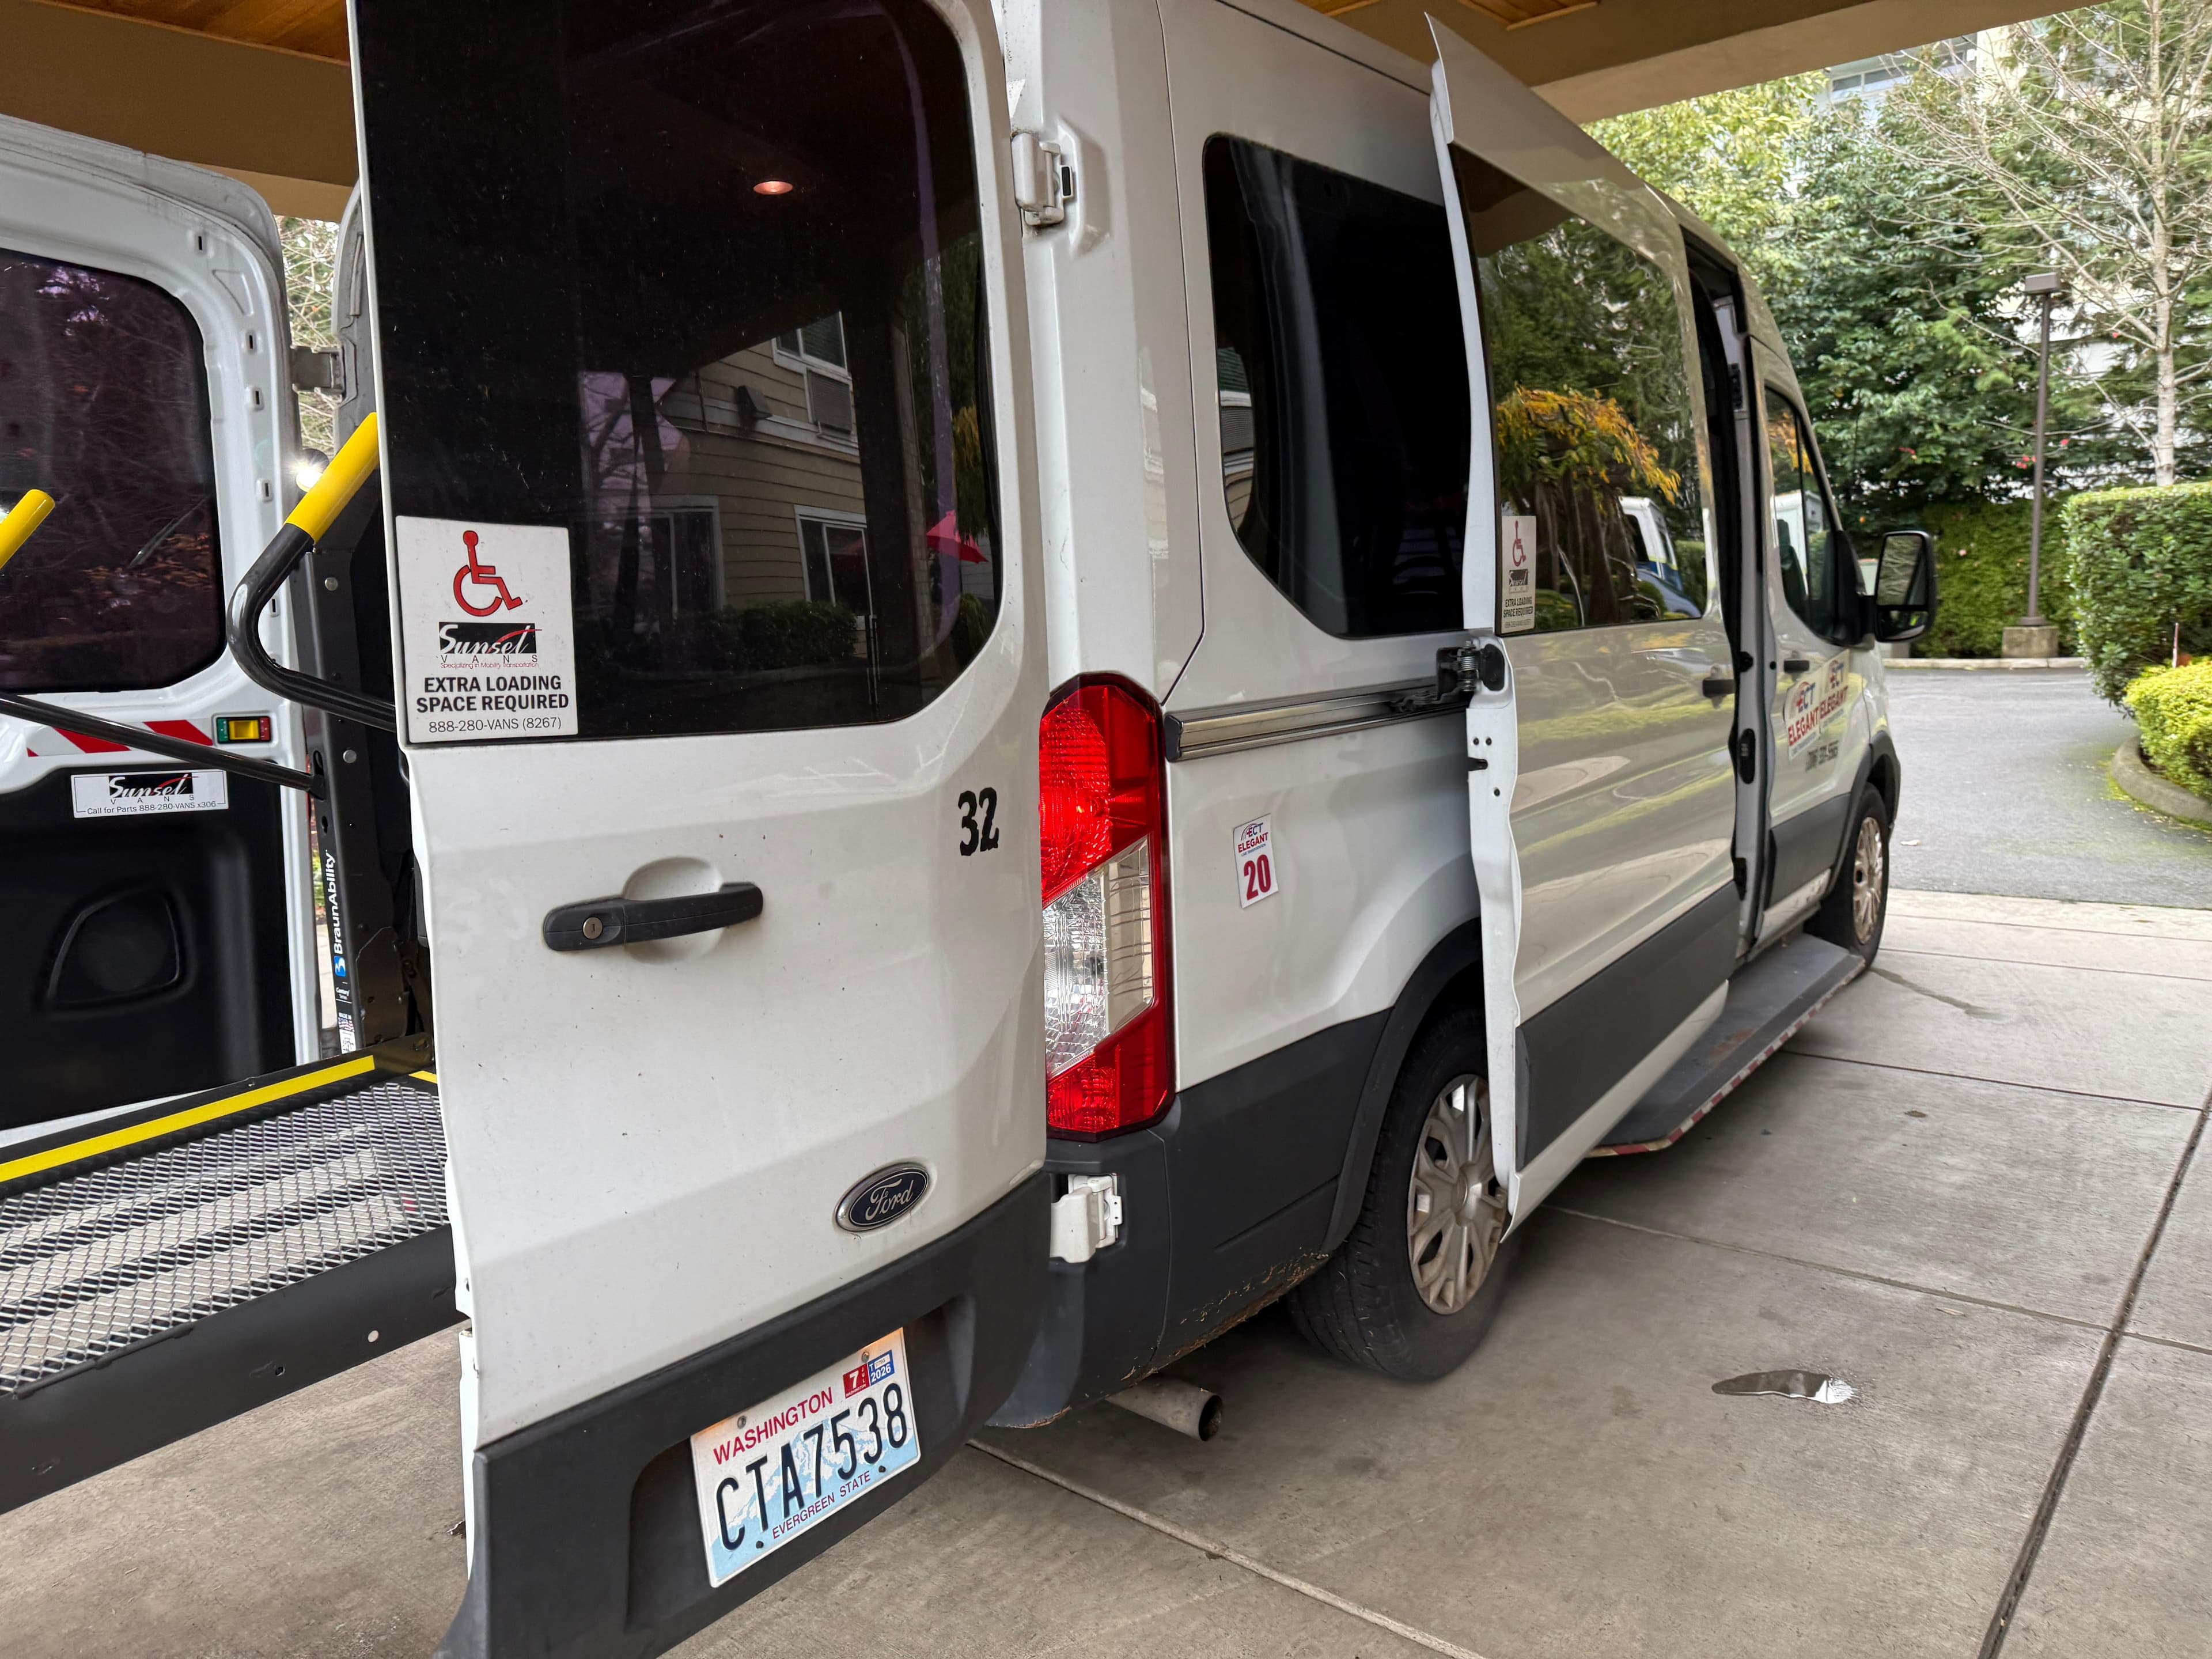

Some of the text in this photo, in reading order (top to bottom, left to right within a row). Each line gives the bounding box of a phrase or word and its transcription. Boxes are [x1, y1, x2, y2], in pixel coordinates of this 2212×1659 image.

[439, 624, 531, 654] Sunset
[424, 675, 562, 693] EXTRA LOADING
[416, 693, 570, 713] SPACE REQUIRED
[429, 717, 562, 733] 888-280-VANS (8267)
[1787, 706, 1820, 747] ELEGANT
[109, 774, 189, 798] Sunset
[87, 807, 102, 815] Call
[116, 805, 137, 813] Parts
[139, 802, 195, 812] 888-280-VANS
[957, 787, 1000, 857] 32
[1238, 832, 1268, 853] ELEGANT
[1247, 823, 1263, 838] ECT
[1243, 854, 1271, 901] 20
[325, 852, 344, 955] BraunAbility
[865, 1178, 914, 1221] Ford
[849, 1370, 859, 1389] 7
[870, 1363, 892, 1383] 2026
[713, 1386, 834, 1465] WASHINGTON
[715, 1382, 908, 1551] CTA7538
[772, 1470, 871, 1540] EVERGREEN STATE
